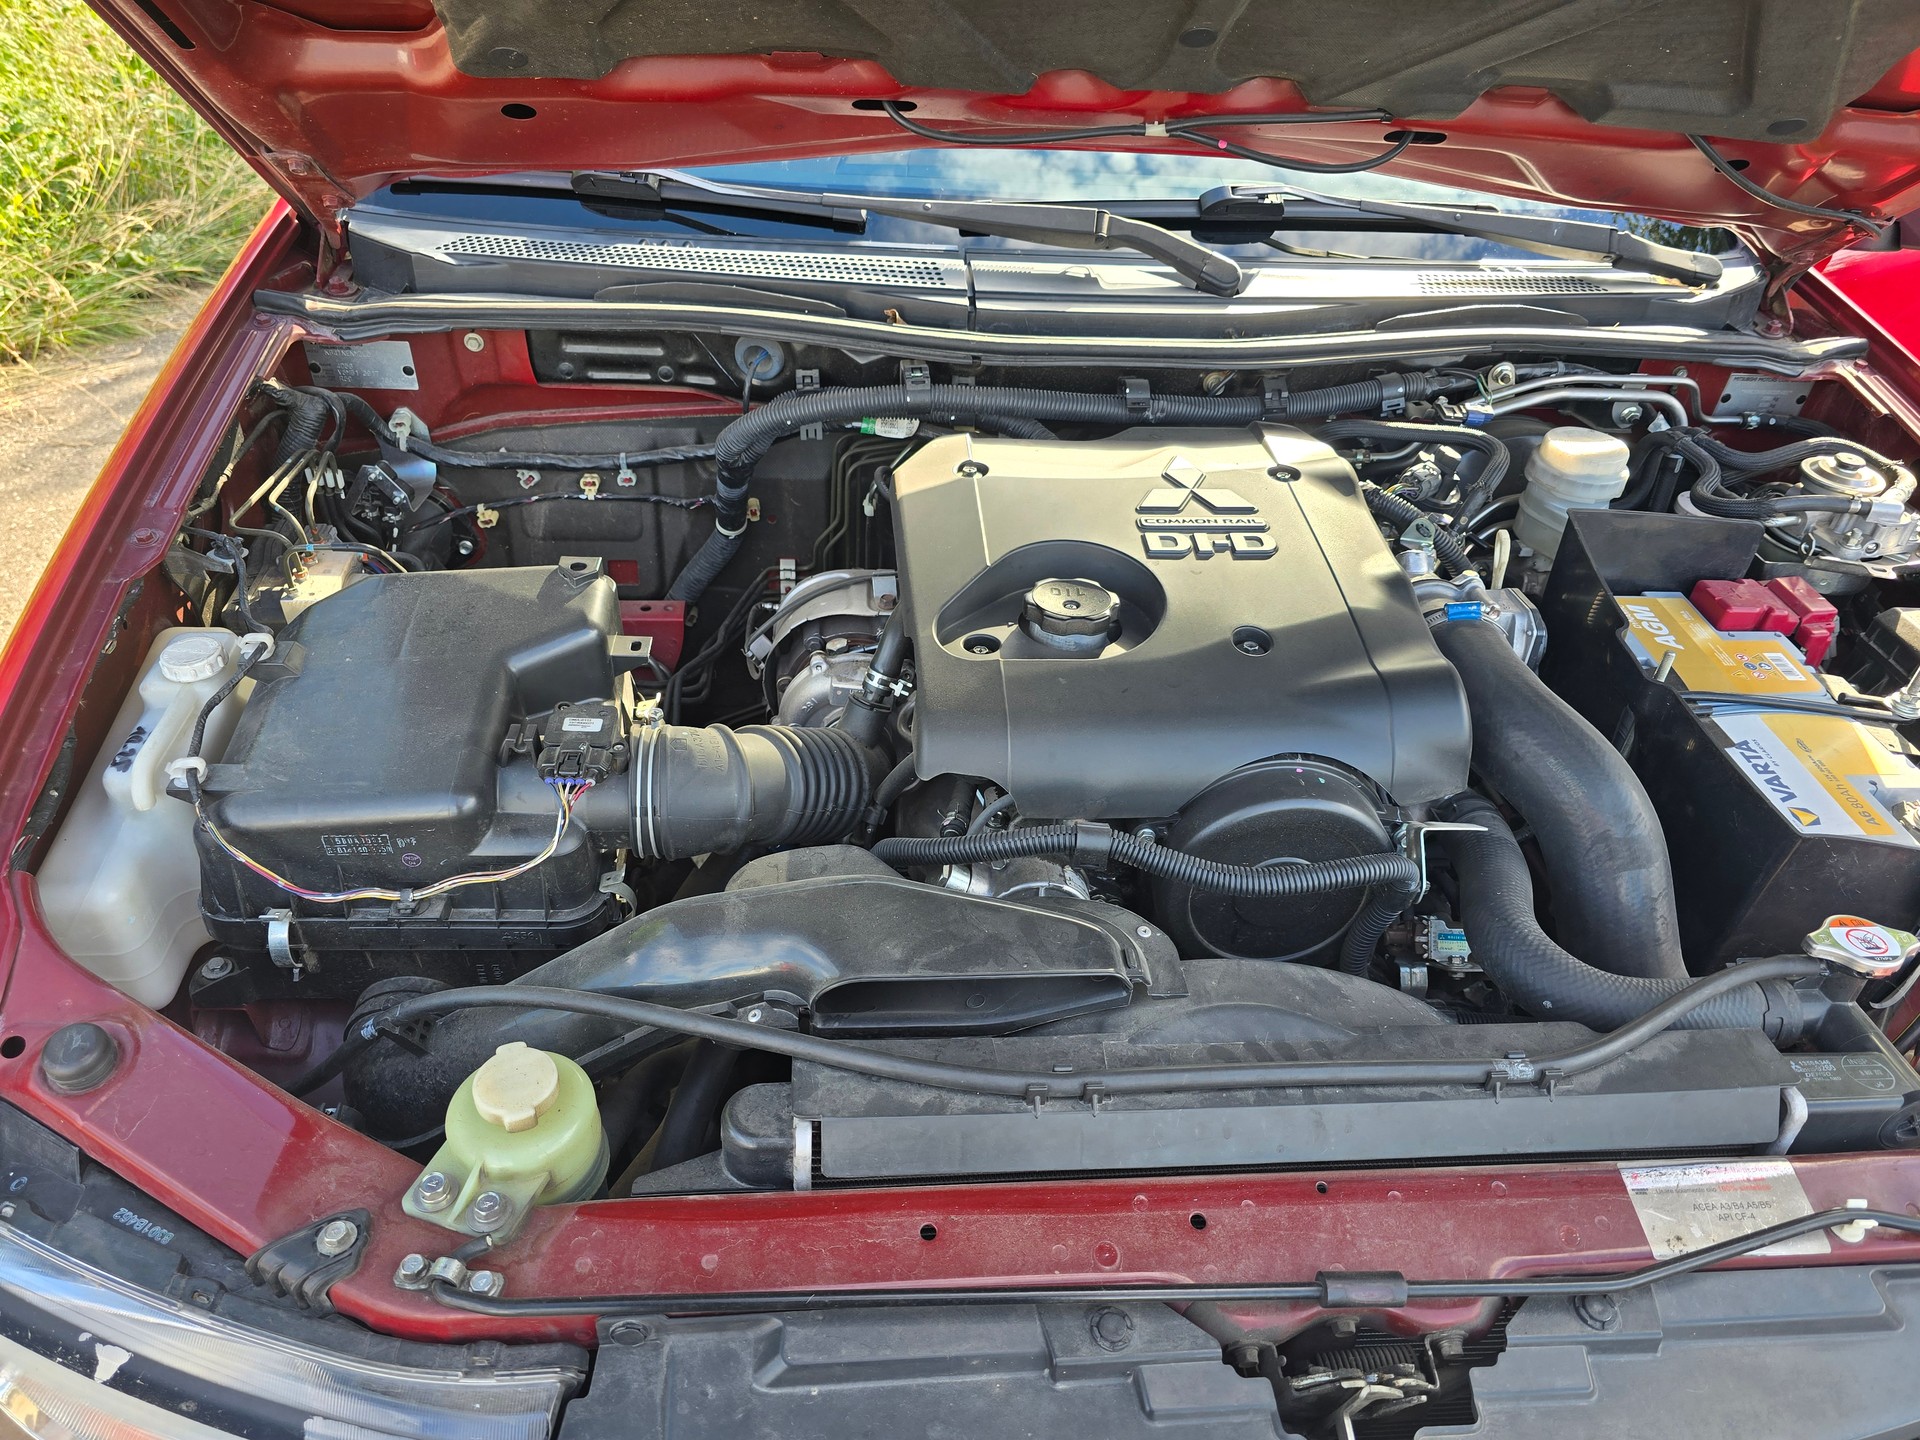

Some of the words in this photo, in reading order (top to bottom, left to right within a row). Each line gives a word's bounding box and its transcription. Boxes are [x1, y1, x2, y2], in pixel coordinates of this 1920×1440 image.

[1141, 532, 1279, 560] DI-D
[1050, 586, 1087, 597] OIL
[1626, 604, 1685, 650] AGM
[1734, 739, 1798, 804] VARTA
[1858, 809, 1881, 826] A6
[1692, 1202, 1719, 1212] ACEA
[1718, 1212, 1733, 1222] API
[1734, 1212, 1756, 1221] CF-4
